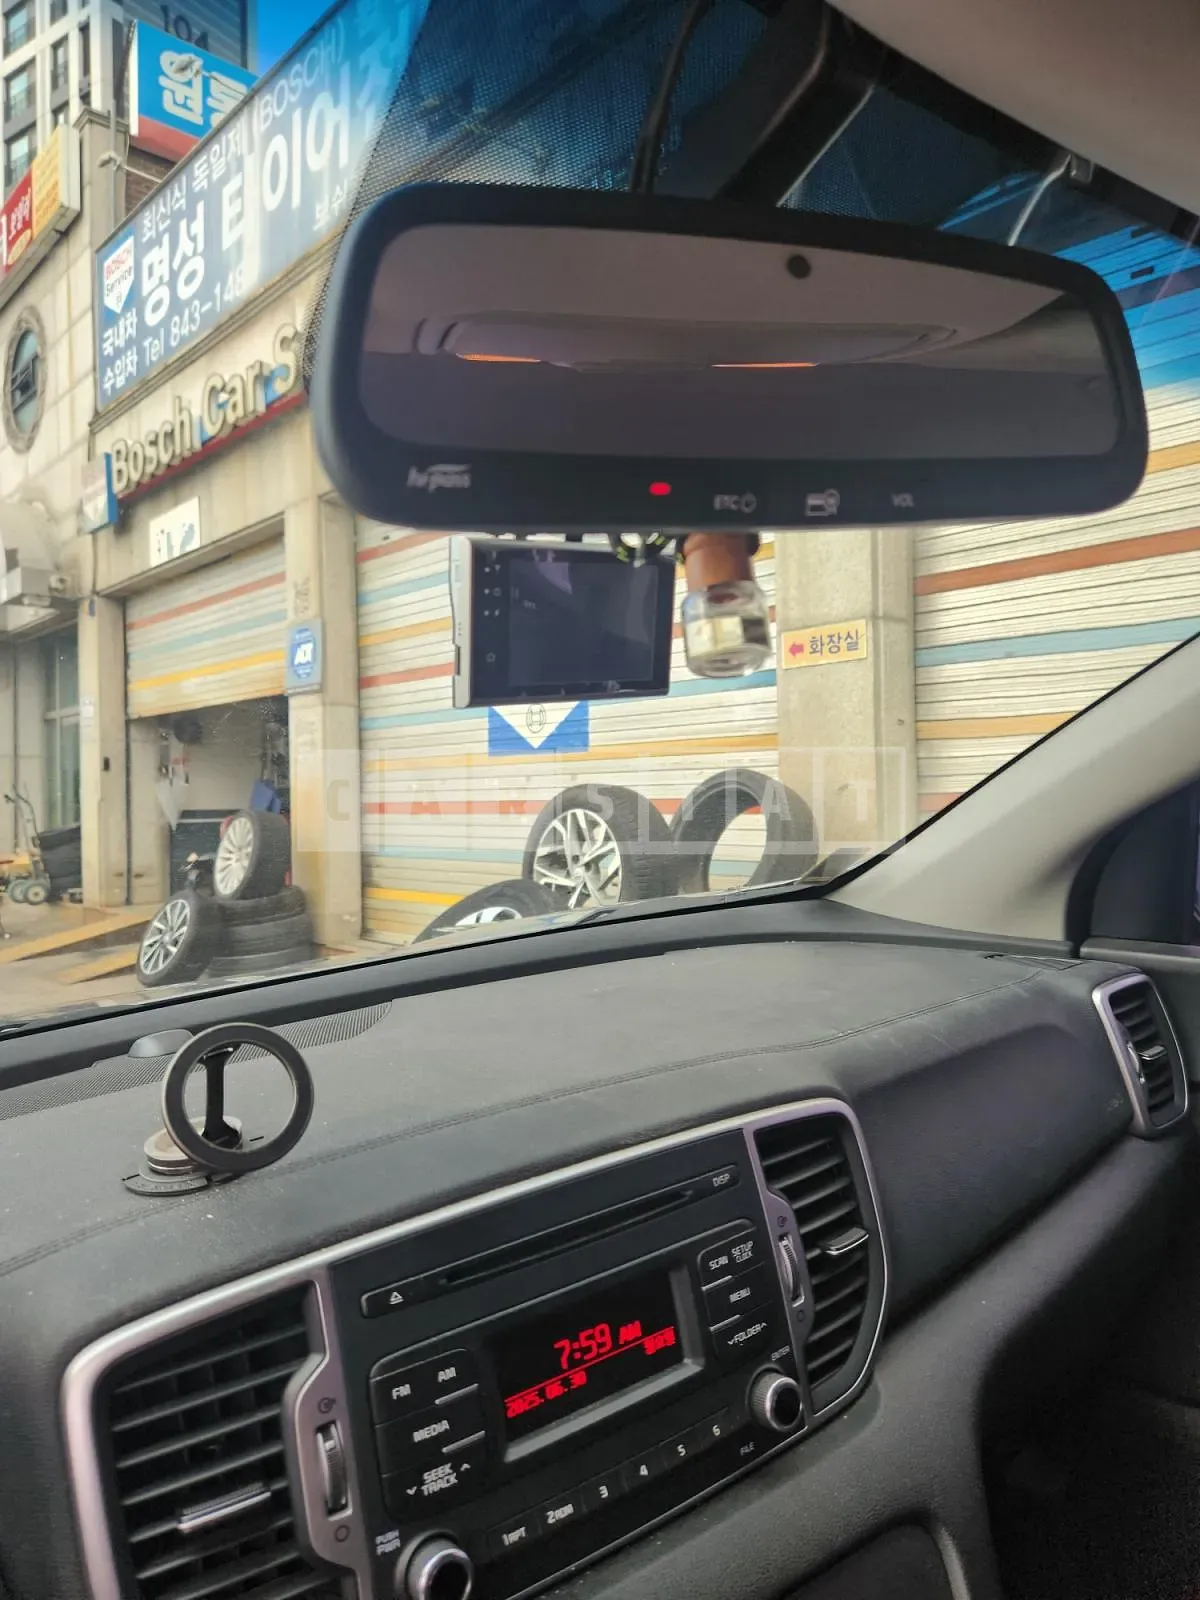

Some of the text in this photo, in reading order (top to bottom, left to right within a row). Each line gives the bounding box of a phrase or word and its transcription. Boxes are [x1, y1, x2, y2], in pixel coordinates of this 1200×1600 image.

[142, 199, 205, 328] 명성
[102, 307, 138, 357] 국내차
[142, 327, 166, 368] Tel
[102, 344, 138, 397] 수입차
[111, 394, 196, 494] Bosch
[202, 359, 263, 437] Car
[808, 627, 860, 656] 화장실
[731, 1240, 754, 1257] SETUP
[729, 1287, 751, 1303] MENU
[734, 1323, 762, 1342] FOLDER
[553, 1320, 642, 1370] 7:59 AM
[437, 1366, 457, 1383] AM
[391, 1383, 412, 1400] FM
[412, 1419, 451, 1444] MEDIA
[712, 1424, 721, 1436] 6
[676, 1443, 687, 1457] 5
[422, 1462, 454, 1484] SEEK
[639, 1464, 649, 1476] 4
[420, 1471, 459, 1497] TRACK
[598, 1485, 609, 1500] 3
